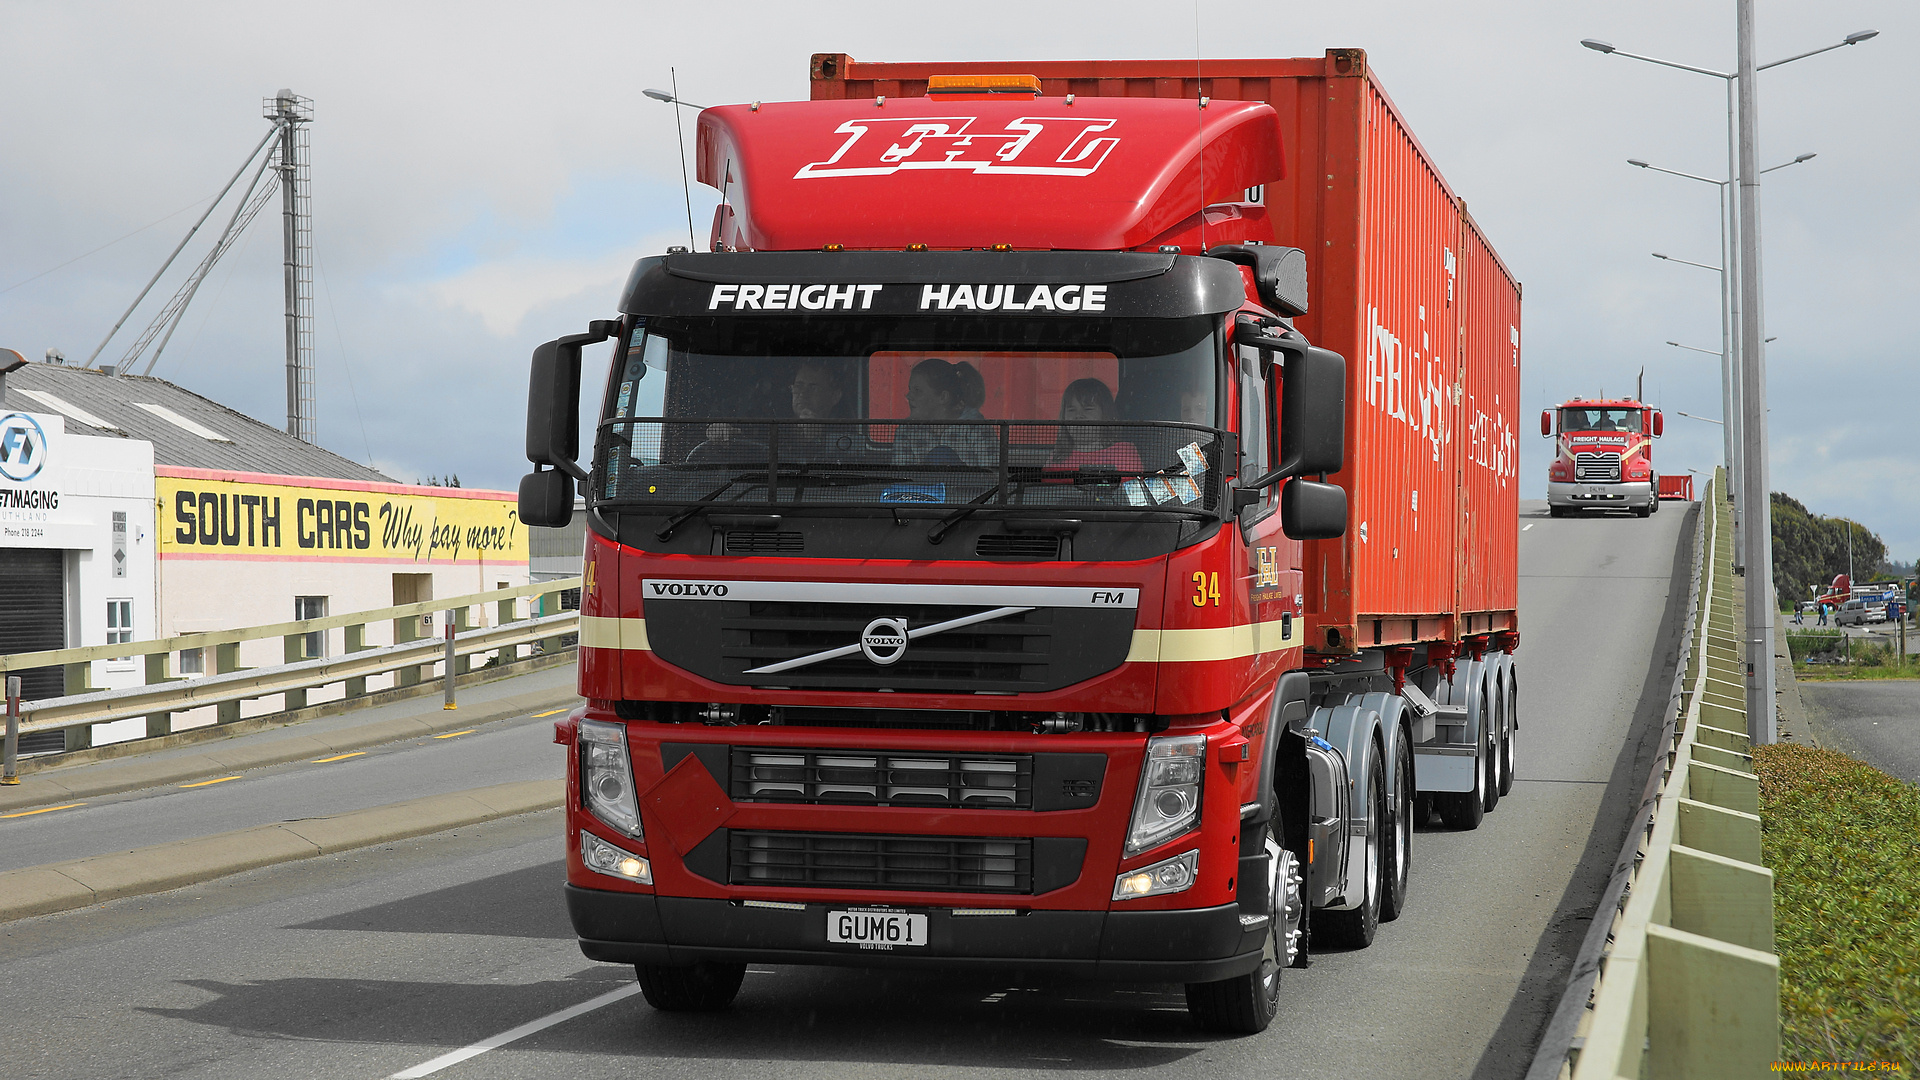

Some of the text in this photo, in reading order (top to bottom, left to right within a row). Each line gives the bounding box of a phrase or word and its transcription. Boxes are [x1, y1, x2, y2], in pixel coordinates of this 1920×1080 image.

[708, 284, 1108, 311] FREIGHT HAULAGE
[4, 527, 43, 537] Phone 218 2244
[175, 490, 517, 562] SOUTH CARS Why pay more?
[650, 583, 729, 597] VOLVO
[1192, 571, 1221, 607] 34
[1091, 591, 1125, 604] FM
[424, 616, 433, 624] 61
[864, 637, 904, 646] VOLVO
[838, 915, 913, 942] GUM61
